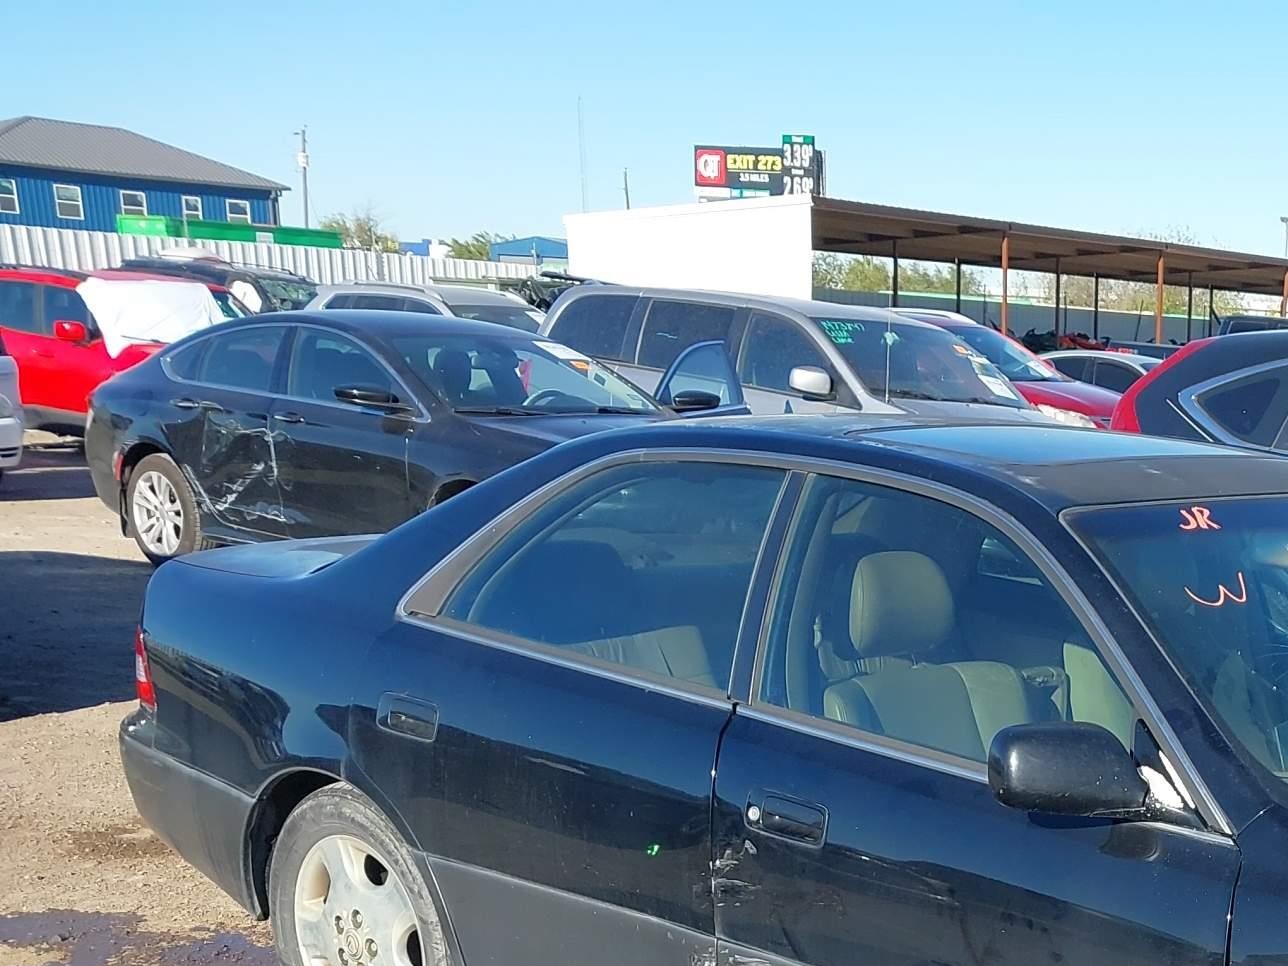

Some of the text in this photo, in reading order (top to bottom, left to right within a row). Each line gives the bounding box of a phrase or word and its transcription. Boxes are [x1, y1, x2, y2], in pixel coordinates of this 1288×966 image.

[726, 154, 783, 171] EXIT 273
[1179, 506, 1223, 529] JR
